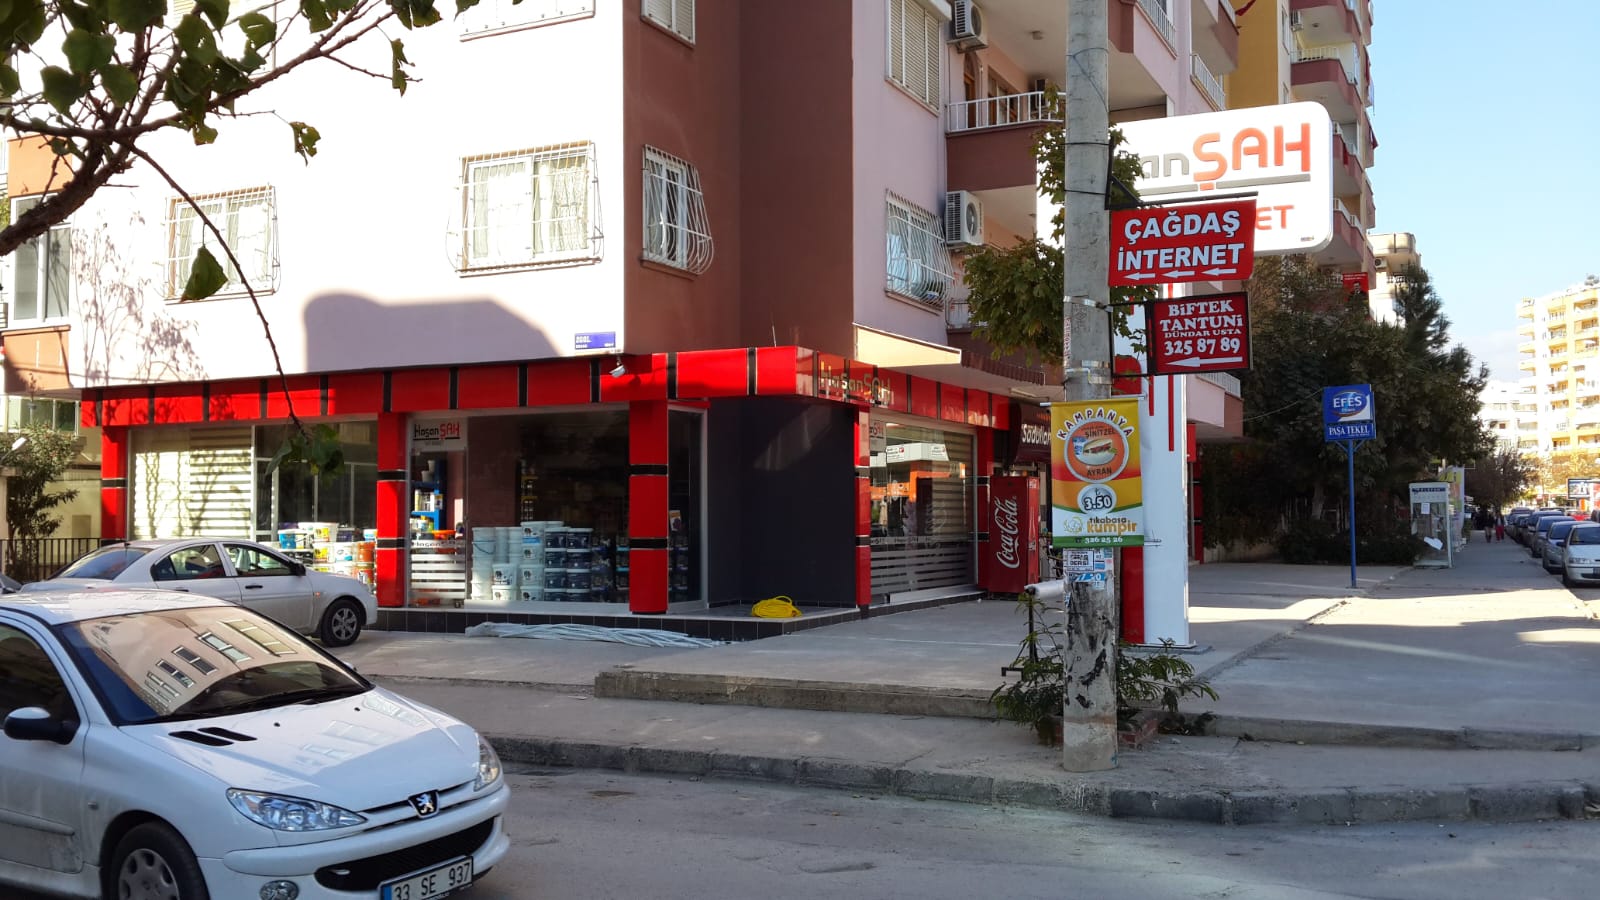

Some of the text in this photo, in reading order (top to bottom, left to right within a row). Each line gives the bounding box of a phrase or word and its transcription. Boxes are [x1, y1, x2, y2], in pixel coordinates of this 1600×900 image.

[1124, 210, 1240, 245] ÇAĞDAŞ
[1117, 243, 1245, 271] İNTERNET
[1164, 330, 1210, 338] DÜNDAR
[1164, 336, 1240, 356] 325 87 89
[1333, 396, 1362, 408] EFES
[1057, 408, 1134, 440] KAMPANYA
[1347, 424, 1370, 434] TEKEL
[1086, 467, 1112, 477] AYRAN
[1083, 494, 1112, 511] 3.50
[994, 495, 1020, 569] Coca-Cola
[1087, 520, 1137, 537] kumpir
[394, 862, 470, 900] 33 SE 937
